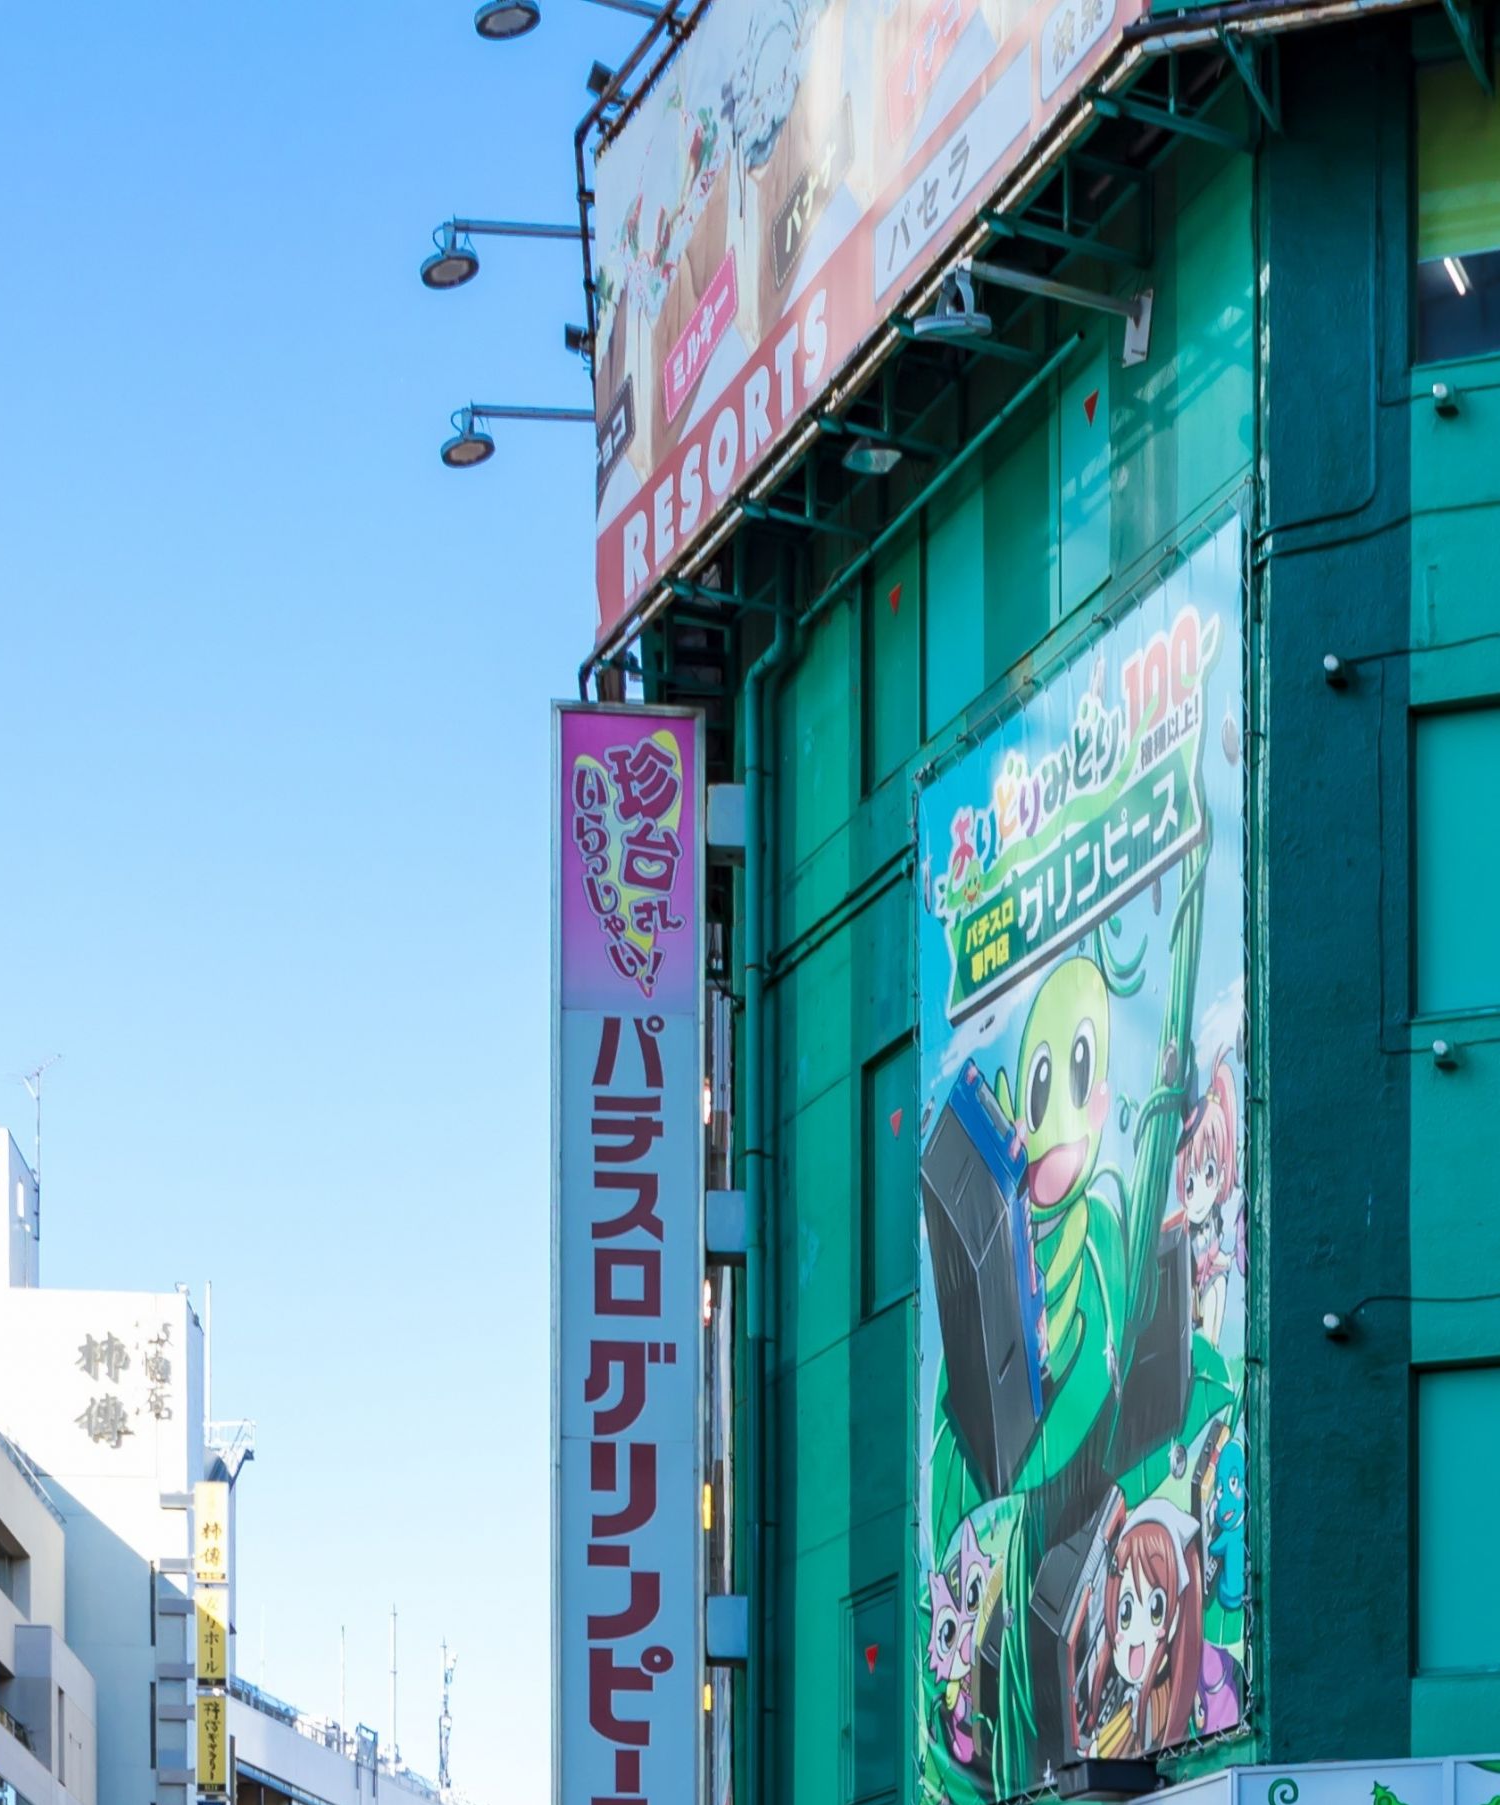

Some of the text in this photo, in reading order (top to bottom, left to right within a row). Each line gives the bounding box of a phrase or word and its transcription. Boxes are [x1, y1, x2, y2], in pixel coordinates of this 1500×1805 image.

[782, 141, 839, 254] バナナ
[885, 141, 972, 273] パセラ
[671, 285, 732, 392] ミルキー
[623, 288, 827, 601] RESORTS
[1122, 612, 1201, 738] 100
[608, 735, 687, 937] 珍台さん
[1017, 770, 1179, 942] グリンピース
[965, 900, 1015, 954] パチスロ
[970, 939, 1009, 983] 専門店
